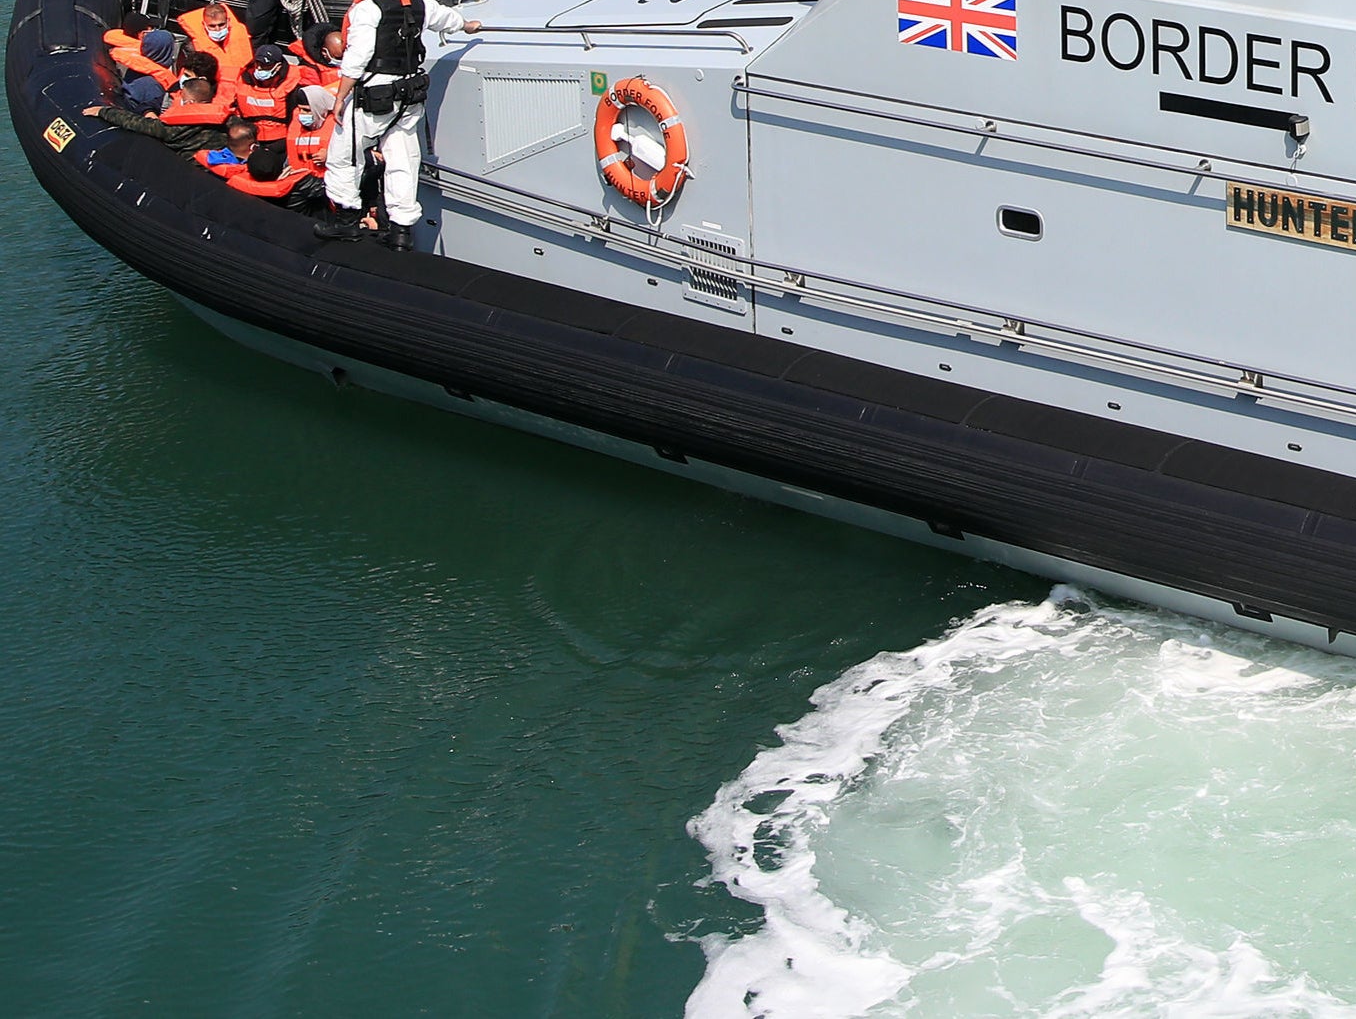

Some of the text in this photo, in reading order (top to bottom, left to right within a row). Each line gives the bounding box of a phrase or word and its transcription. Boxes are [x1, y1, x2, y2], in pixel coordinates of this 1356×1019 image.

[1060, 4, 1335, 104] BORDER
[604, 88, 671, 140] BORDER FORCE
[605, 170, 646, 201] HUNTER
